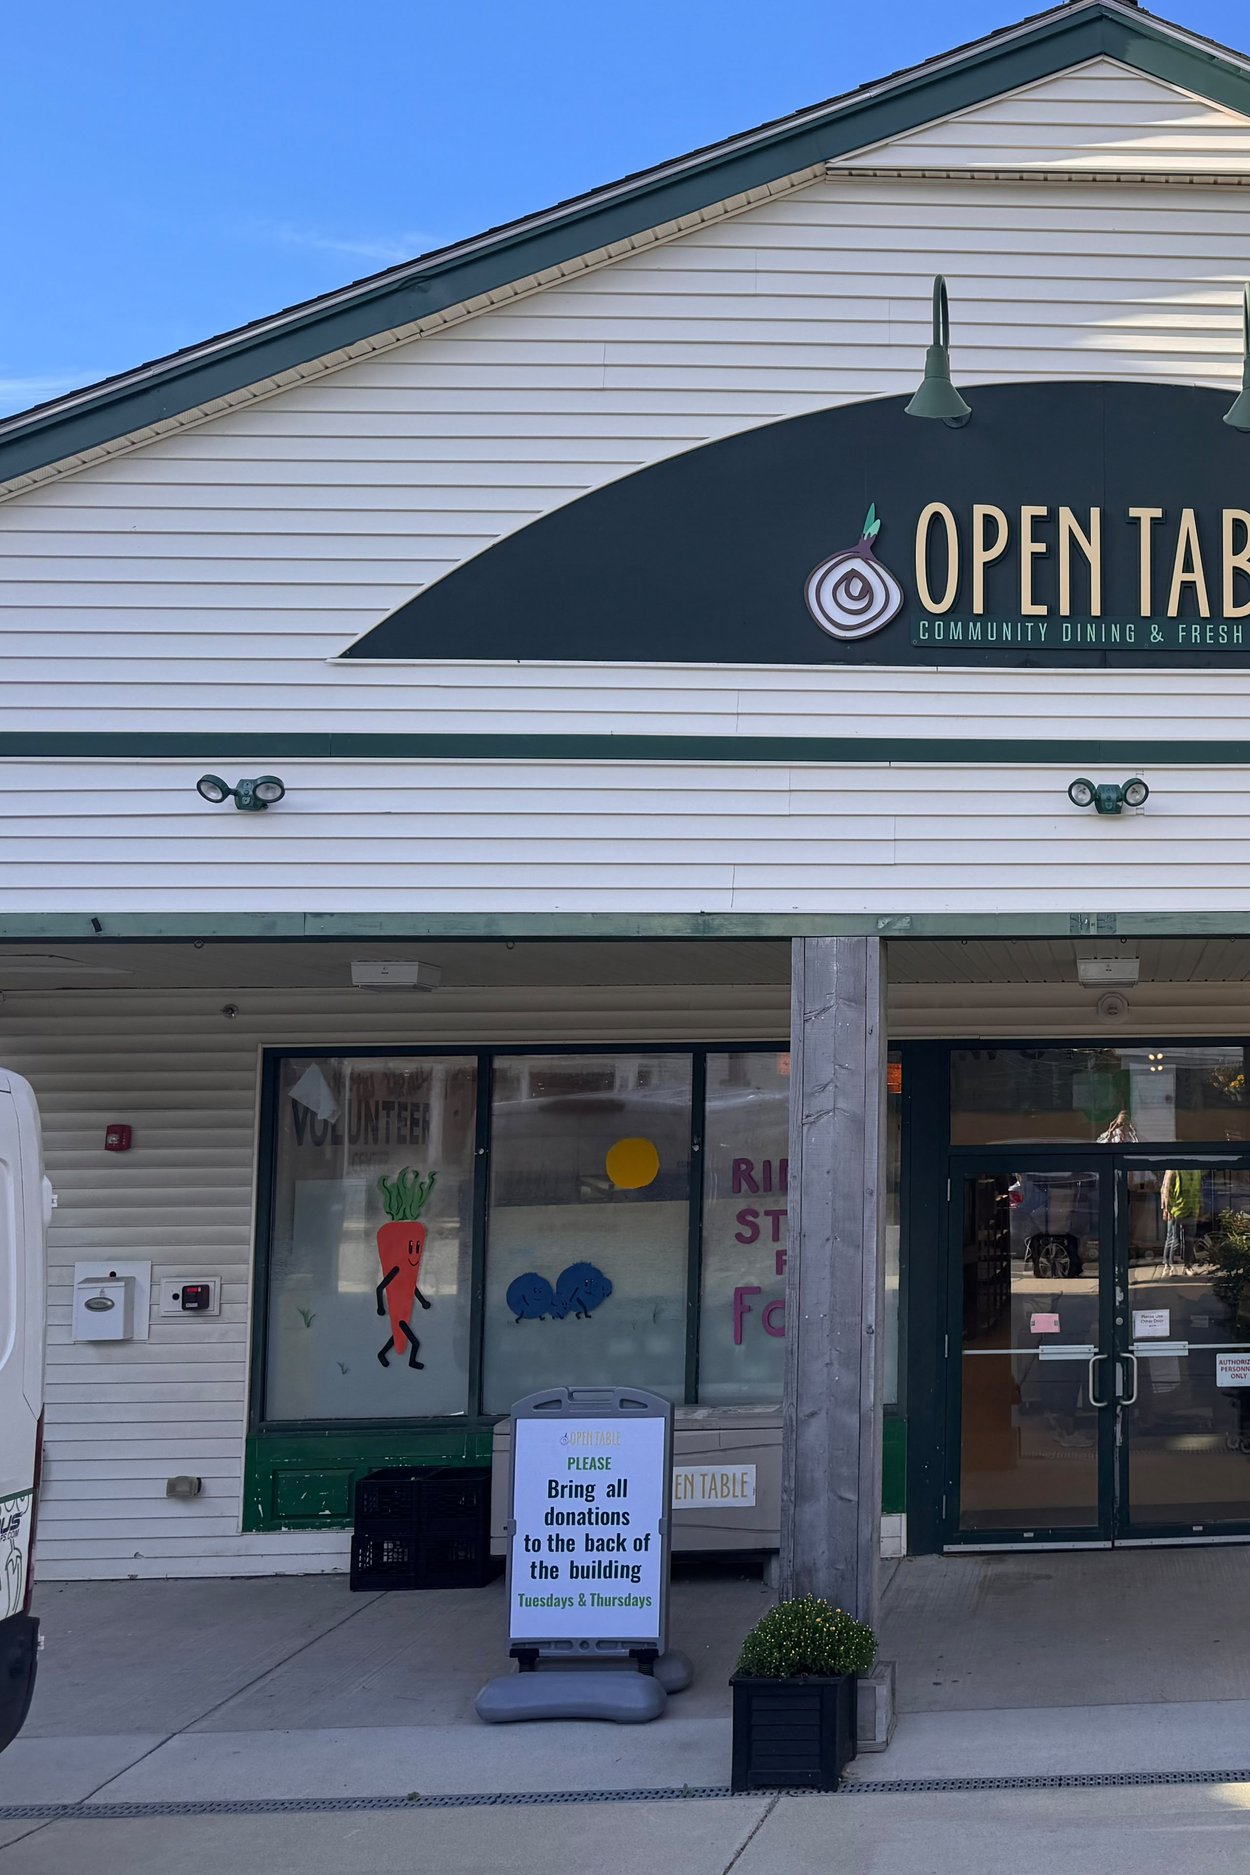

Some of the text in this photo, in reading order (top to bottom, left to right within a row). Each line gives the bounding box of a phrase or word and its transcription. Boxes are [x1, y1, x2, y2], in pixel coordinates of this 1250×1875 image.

[914, 501, 1101, 617] OPEN
[919, 620, 1048, 642] COMMUNITY
[1062, 622, 1135, 643] DINING
[1150, 624, 1164, 643] &
[1178, 624, 1243, 644] FRESH
[734, 1208, 788, 1244] ST
[569, 1431, 622, 1446] OPEN TABLE
[567, 1456, 612, 1471] PLEASE
[547, 1478, 628, 1502] Bring all
[674, 1472, 748, 1500] EN TABLE
[0, 1511, 22, 1535] US
[544, 1506, 630, 1526] donations
[524, 1533, 651, 1552] to the back of
[530, 1560, 642, 1584] the building
[517, 1592, 652, 1610] Tuesdays & Thursdays
